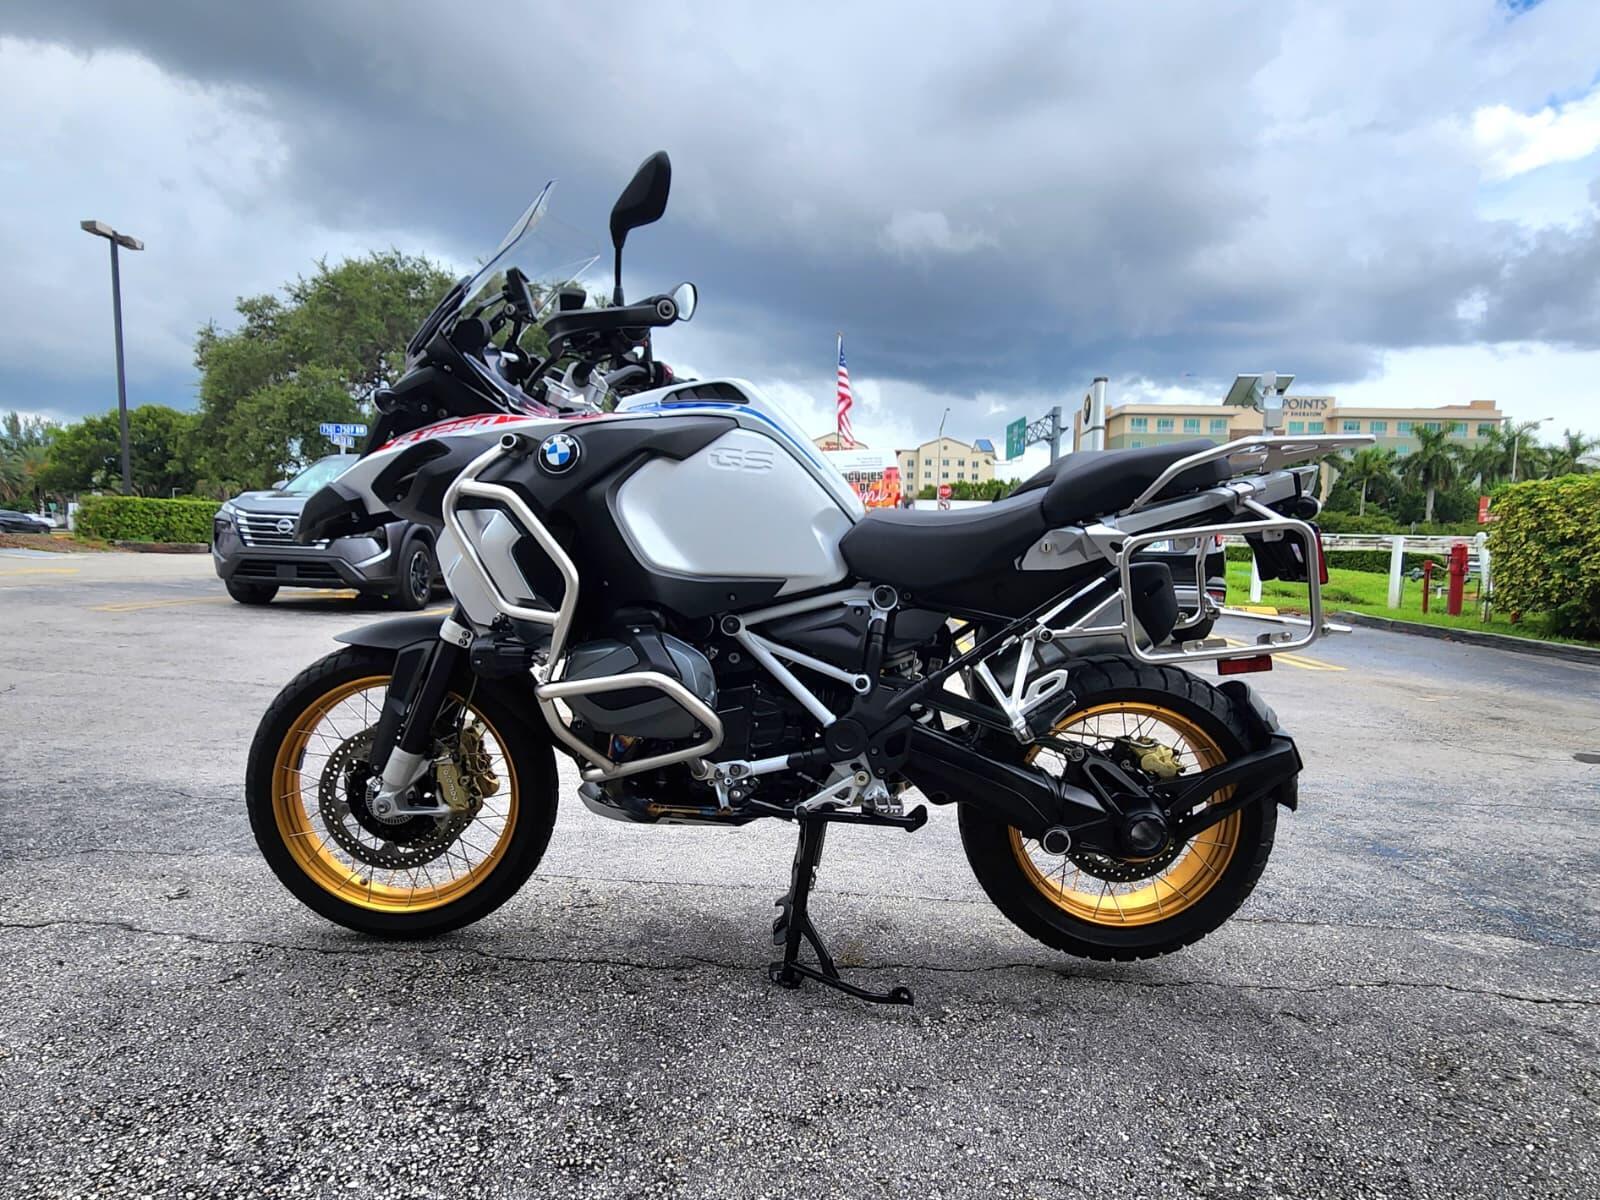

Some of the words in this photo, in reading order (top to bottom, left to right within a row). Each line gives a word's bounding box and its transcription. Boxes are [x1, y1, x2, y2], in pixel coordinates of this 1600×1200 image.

[1282, 398, 1328, 410] POINTS
[543, 435, 575, 450] BMW
[708, 447, 774, 474] GS
